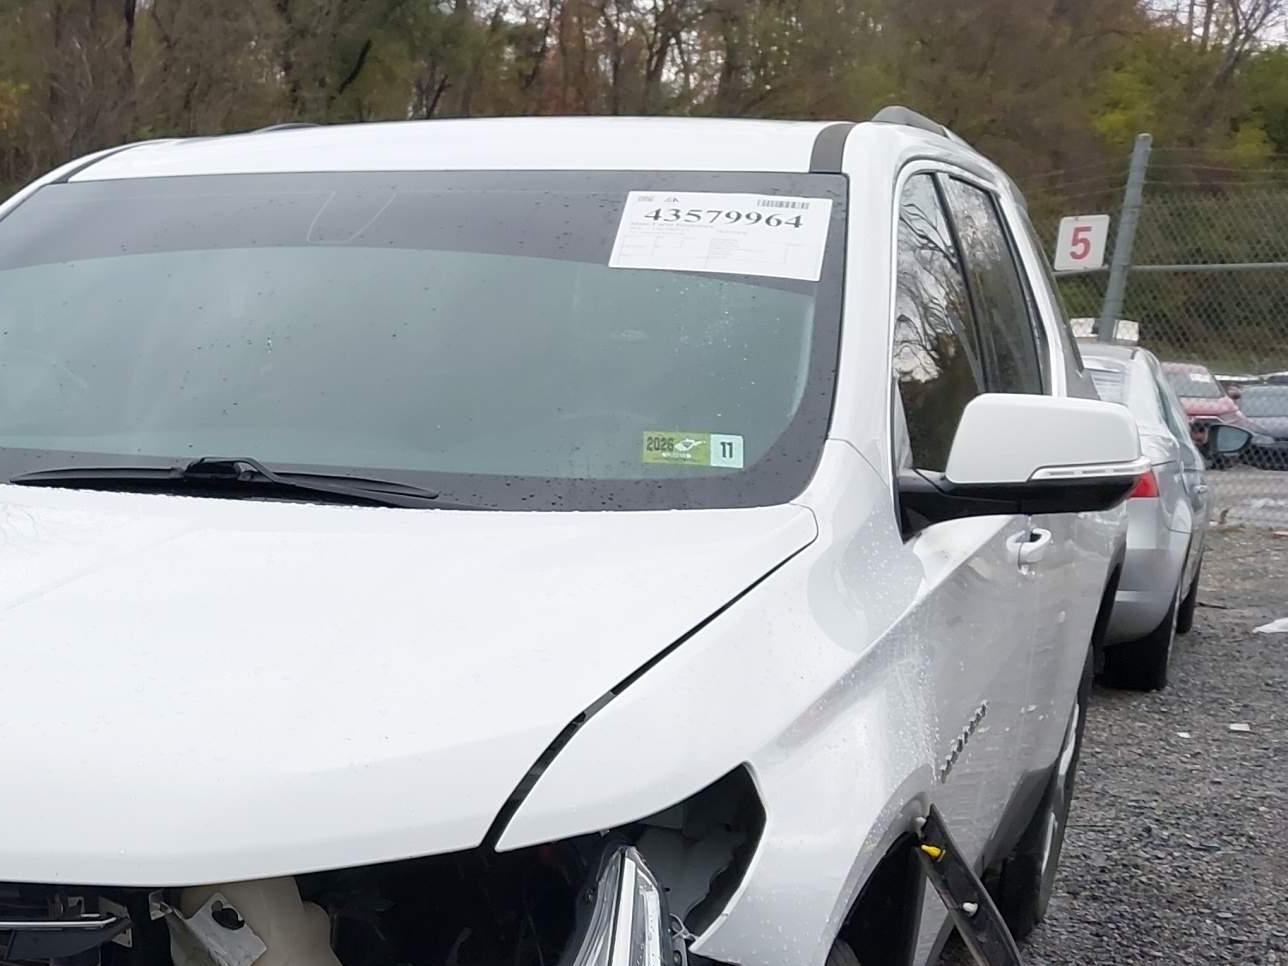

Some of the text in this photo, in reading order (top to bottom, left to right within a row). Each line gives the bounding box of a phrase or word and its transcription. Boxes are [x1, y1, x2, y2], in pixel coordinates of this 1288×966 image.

[643, 207, 804, 229] 43579964
[1070, 226, 1092, 260] 5
[720, 441, 733, 458] 11
